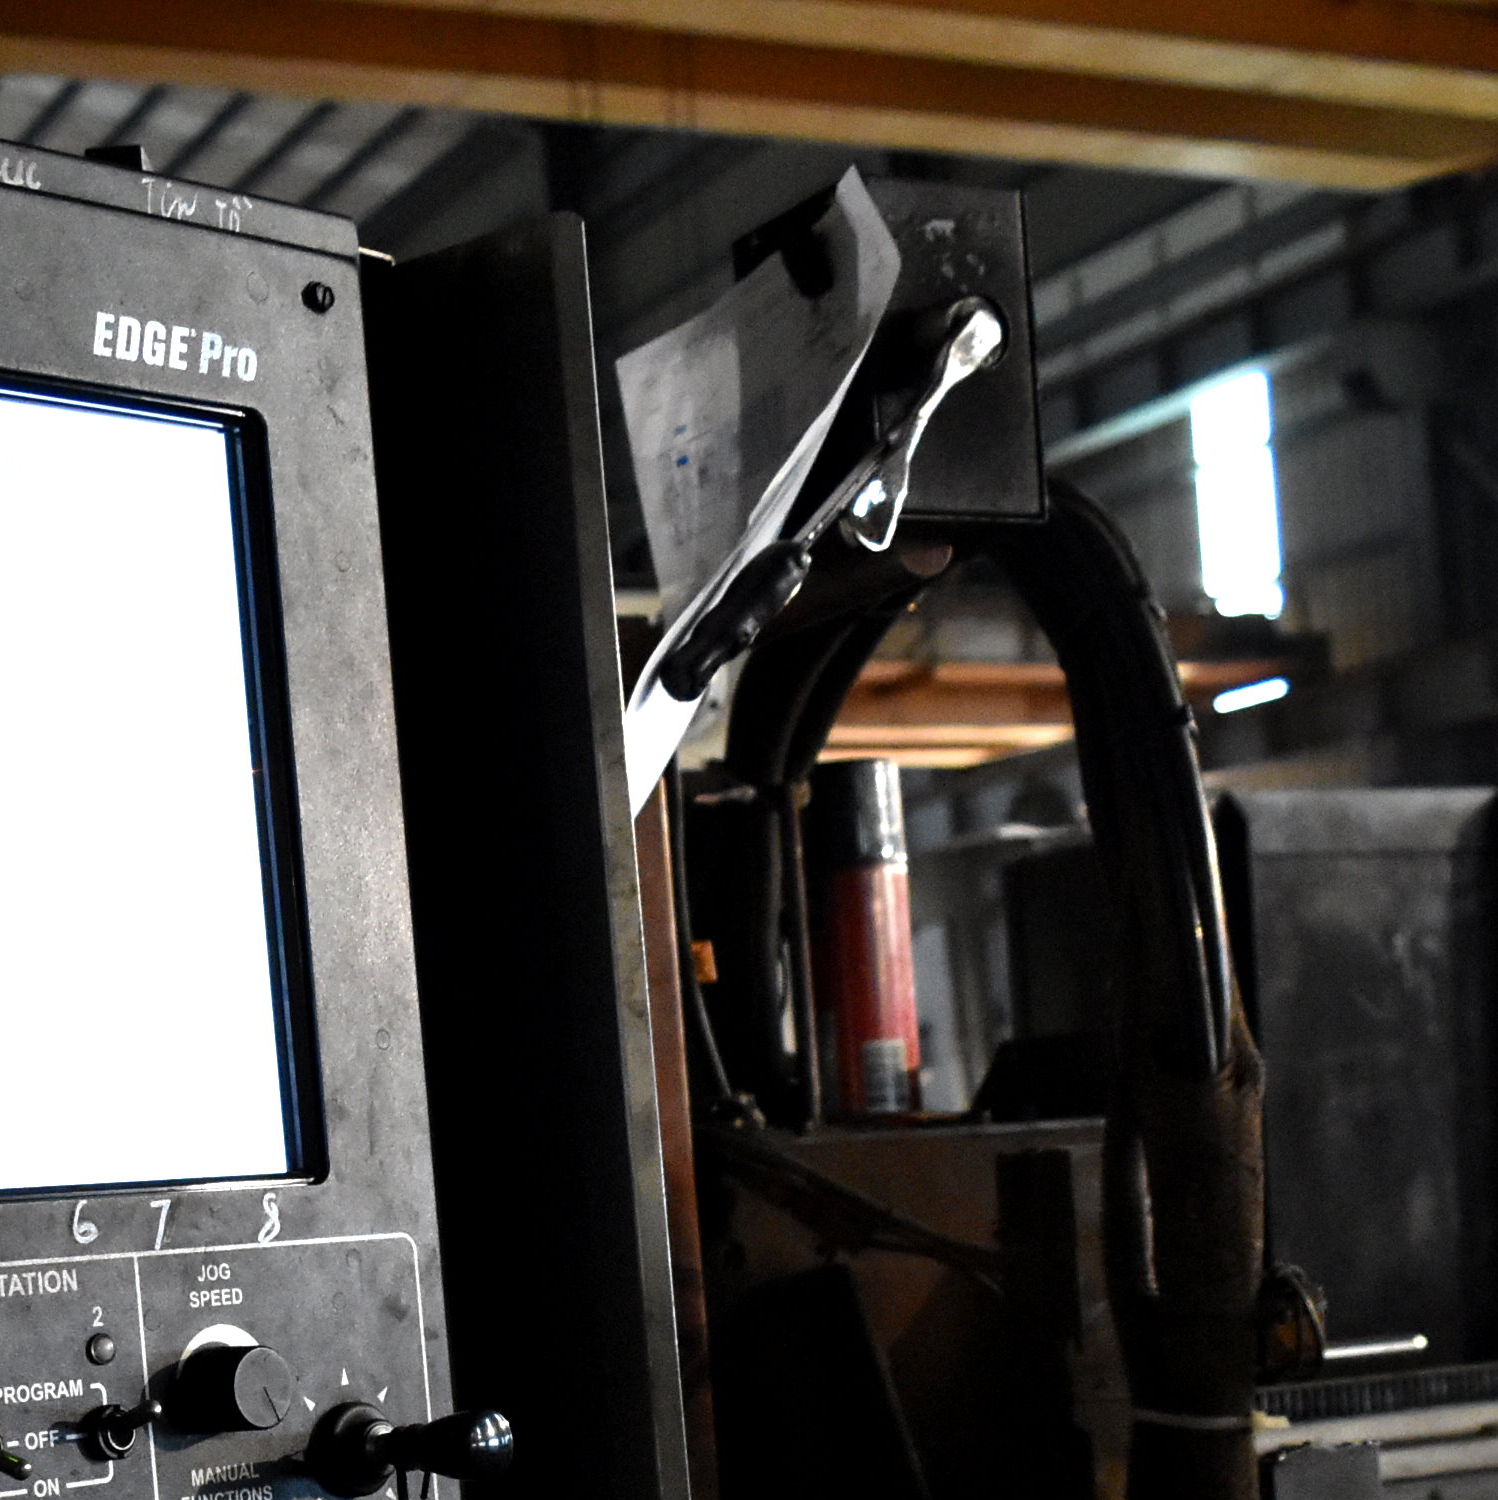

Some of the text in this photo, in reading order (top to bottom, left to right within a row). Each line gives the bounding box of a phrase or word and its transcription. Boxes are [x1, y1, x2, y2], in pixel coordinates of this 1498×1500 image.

[198, 331, 259, 383] Pro
[71, 1199, 100, 1245] 6
[148, 1199, 172, 1251] 7
[257, 1193, 282, 1243] 8
[197, 1262, 232, 1283] JOG
[188, 1287, 244, 1308] SPEED
[92, 1306, 104, 1328] 2
[24, 1429, 61, 1453] OFF
[190, 1462, 261, 1489] MANUAL
[32, 1478, 61, 1499] ON
